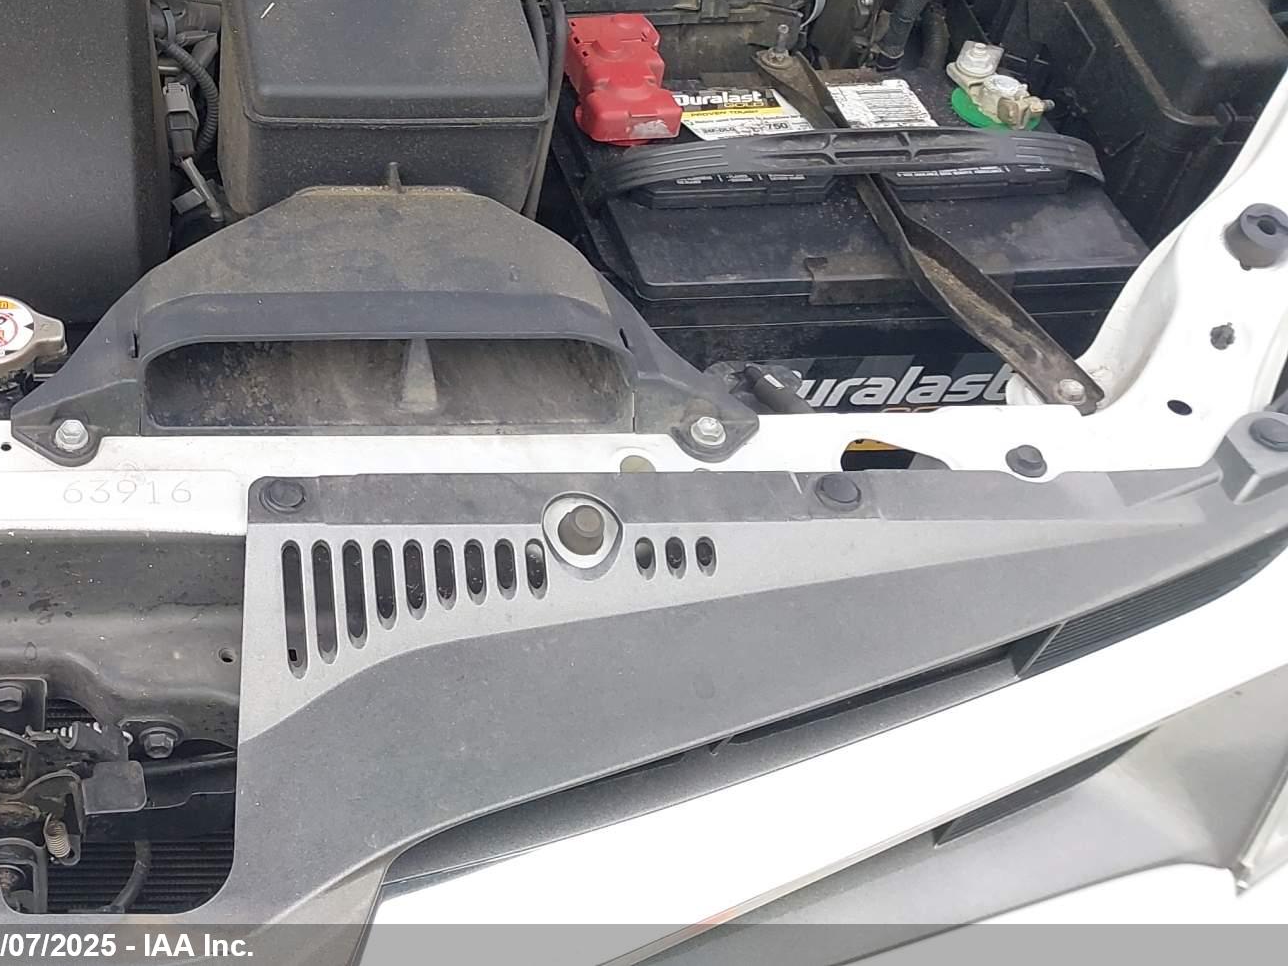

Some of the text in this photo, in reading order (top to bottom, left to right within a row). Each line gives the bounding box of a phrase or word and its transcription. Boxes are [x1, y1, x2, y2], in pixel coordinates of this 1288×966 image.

[672, 91, 763, 107] Duralast
[767, 122, 789, 130] 750
[793, 364, 1010, 407] uralast
[63, 480, 192, 504] 63916
